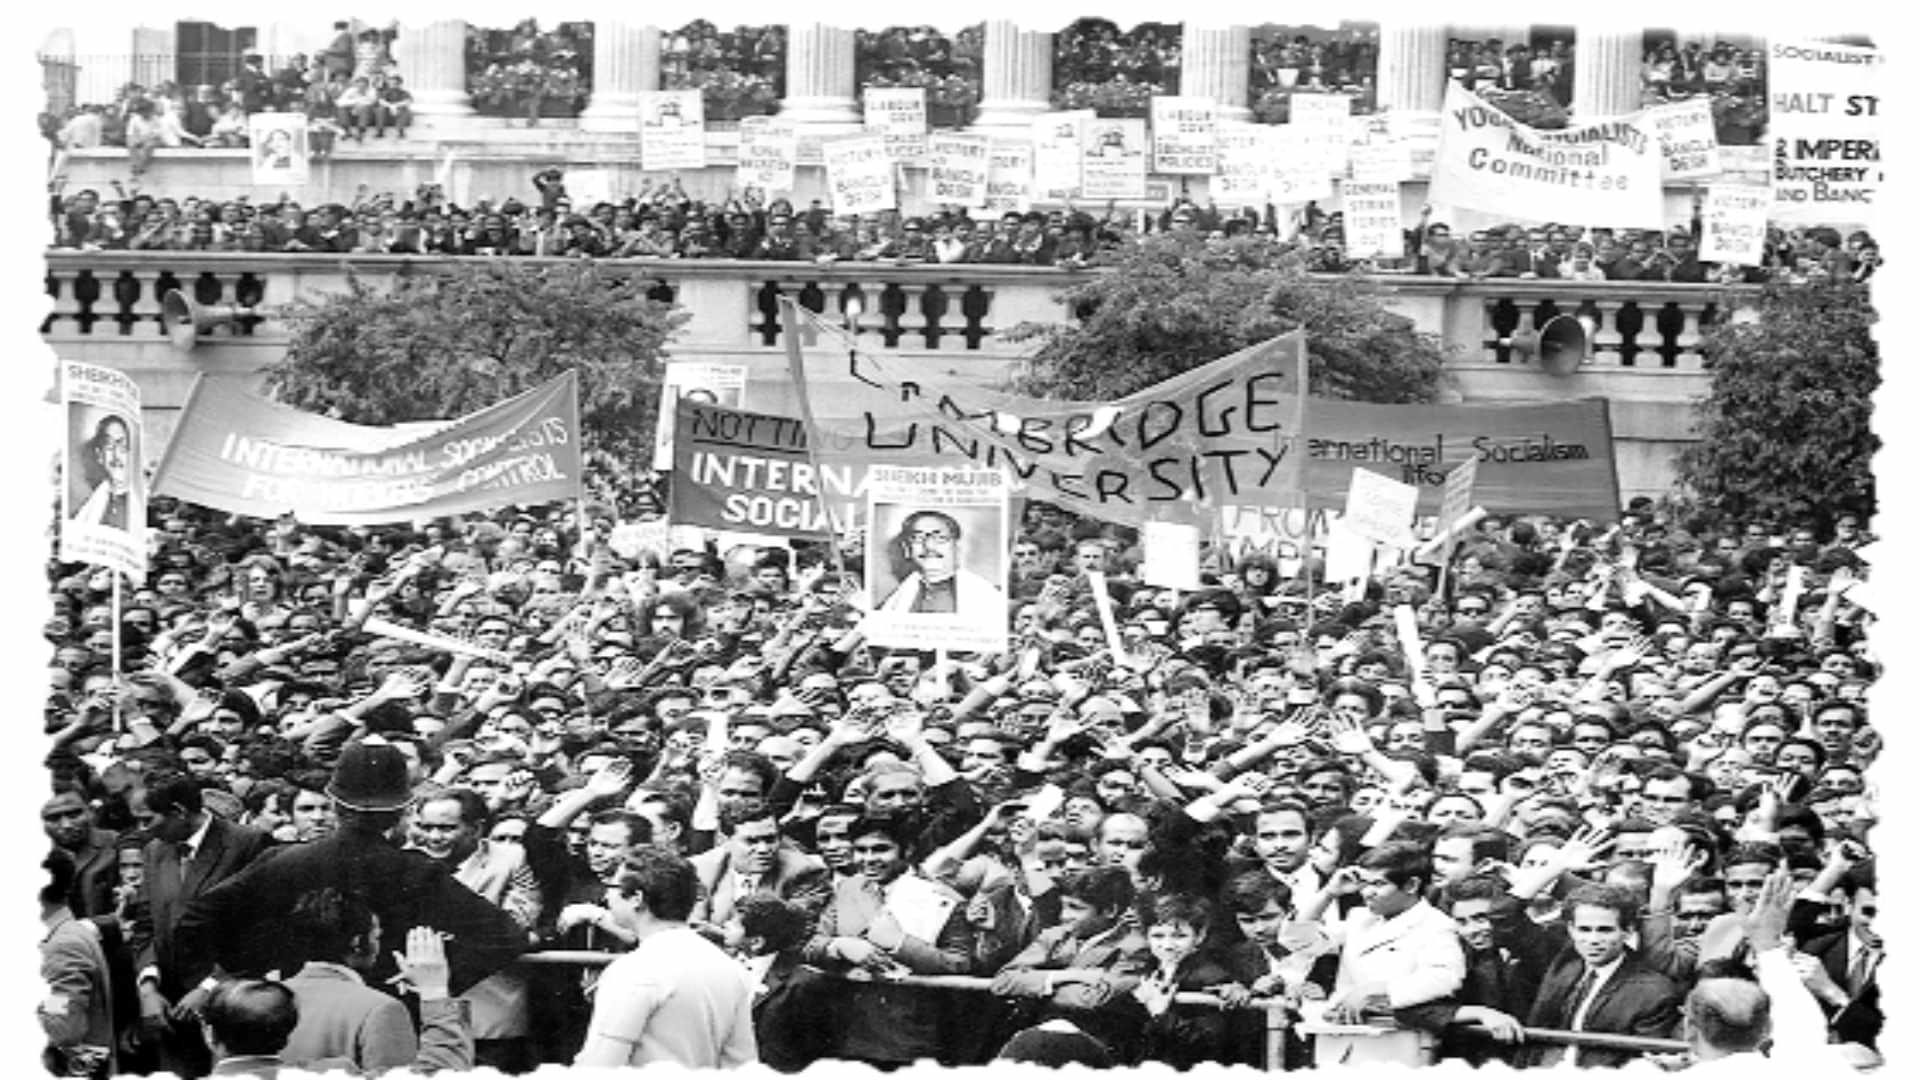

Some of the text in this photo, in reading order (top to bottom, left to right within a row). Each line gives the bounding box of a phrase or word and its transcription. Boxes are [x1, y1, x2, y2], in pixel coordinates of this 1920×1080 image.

[1773, 44, 1875, 65] SOCIALIST
[1773, 92, 1835, 114] HALT
[1157, 155, 1214, 168] POLICIES
[1507, 130, 1609, 167] National
[1468, 147, 1630, 191] Committee
[863, 410, 1290, 504] UNIVERSITY
[1472, 433, 1591, 463] Socialism
